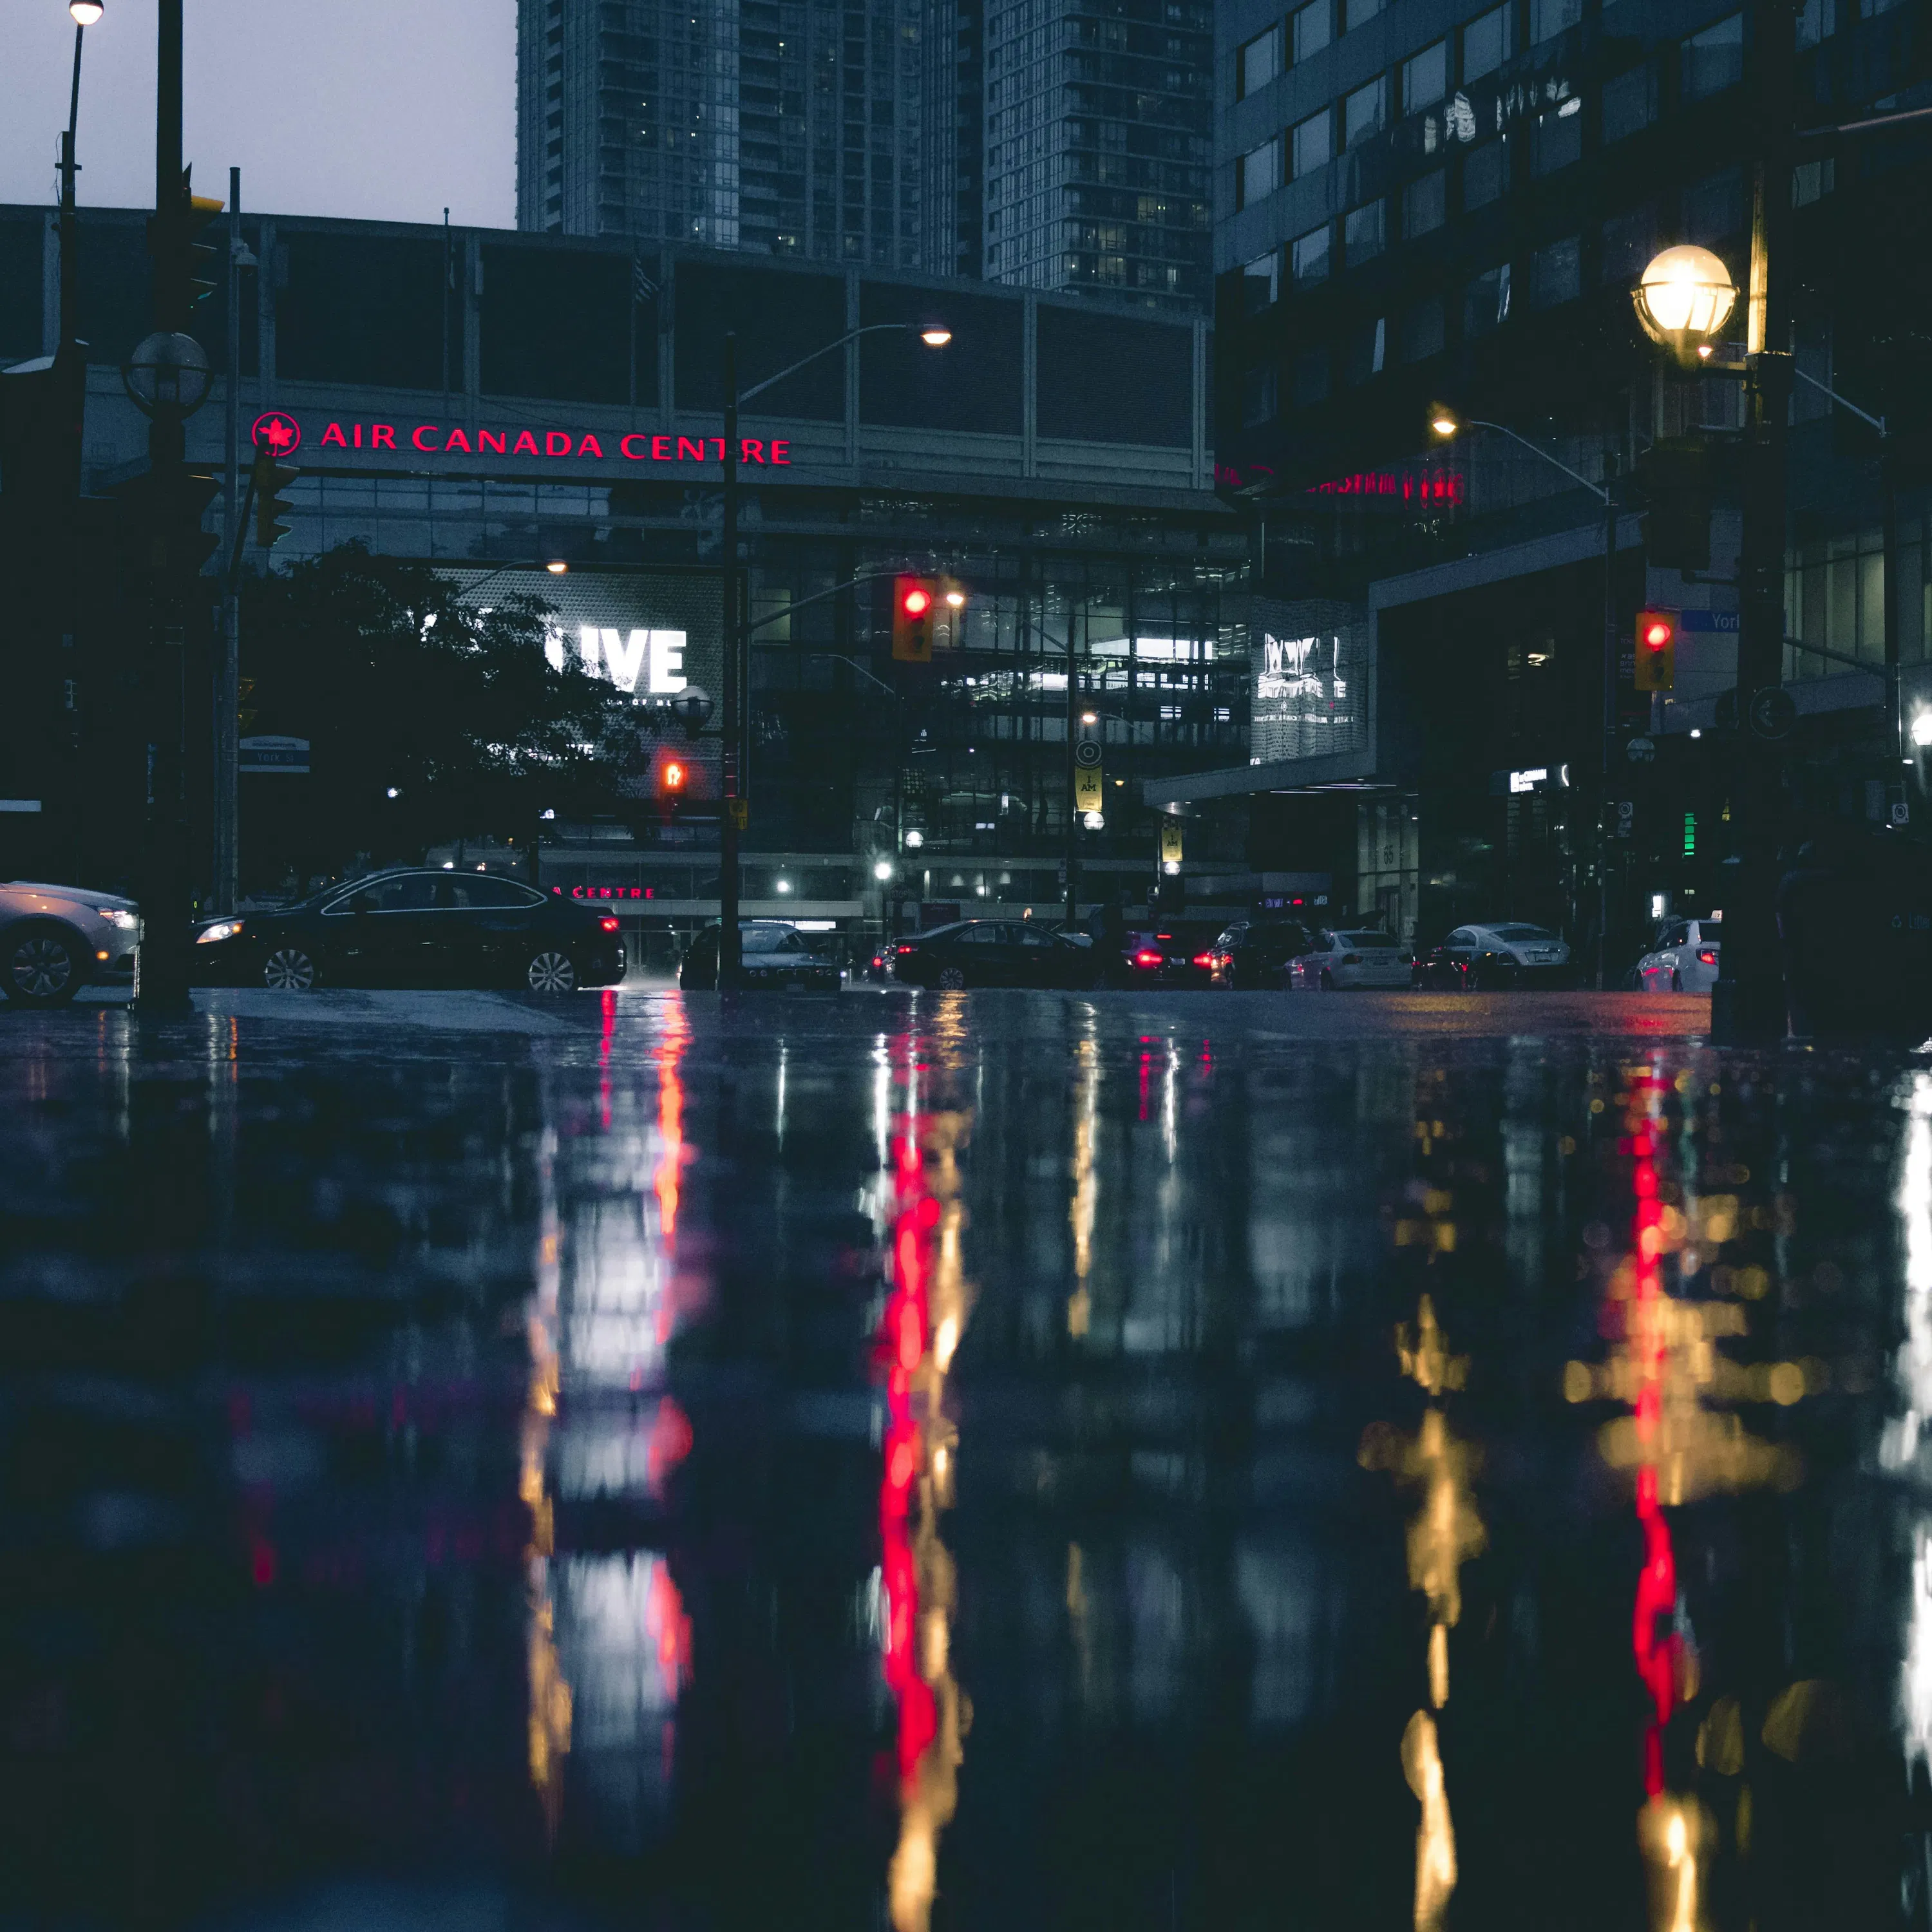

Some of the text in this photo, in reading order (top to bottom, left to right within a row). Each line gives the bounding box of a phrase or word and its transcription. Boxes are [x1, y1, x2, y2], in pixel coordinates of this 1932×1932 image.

[320, 422, 791, 465] AIR CANADA CENTRE
[258, 752, 279, 762] York
[572, 886, 655, 899] CENTRE
